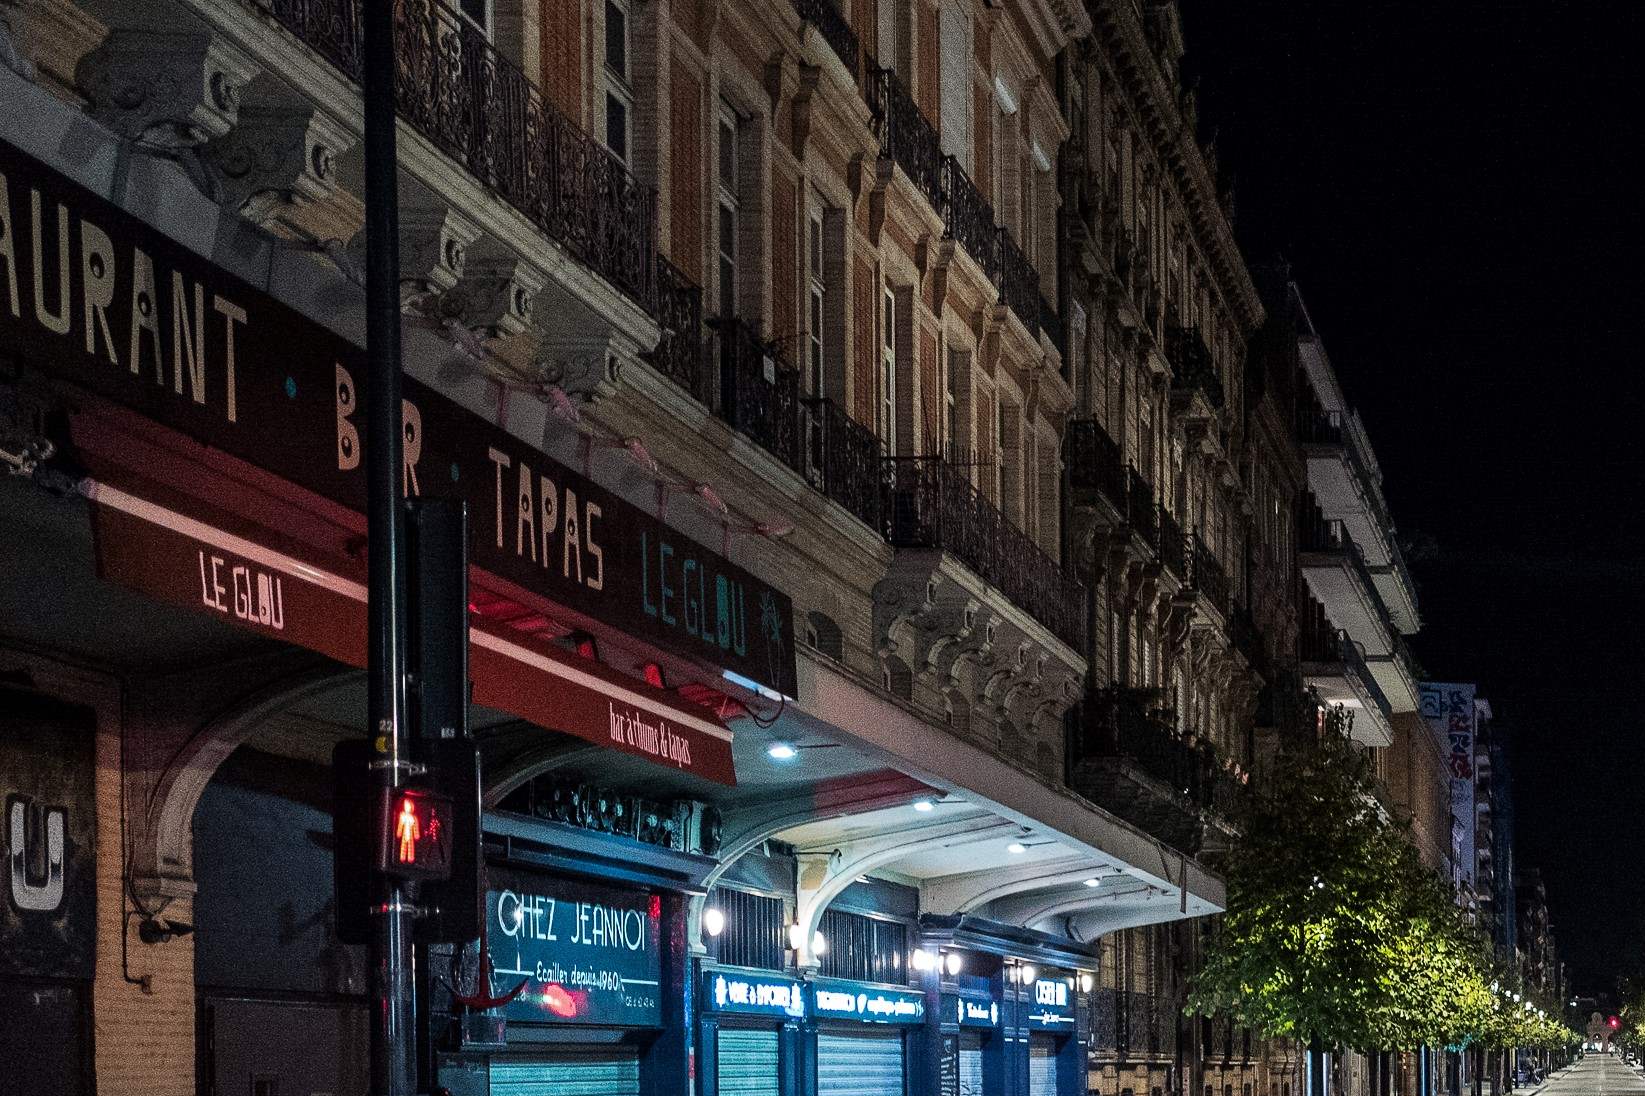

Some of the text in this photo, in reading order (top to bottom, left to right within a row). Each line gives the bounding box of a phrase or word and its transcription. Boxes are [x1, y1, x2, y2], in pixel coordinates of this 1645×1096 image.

[335, 363, 422, 498] BR
[488, 446, 604, 591] TAPAS
[199, 551, 284, 630] LE GLOU
[642, 531, 746, 657] LE GLOU
[609, 701, 625, 744] bar
[633, 711, 660, 755] rhums
[660, 722, 669, 758] &
[668, 725, 692, 769] tapas
[497, 889, 646, 951] CHEZ JEANNOT
[598, 972, 619, 992] 1960
